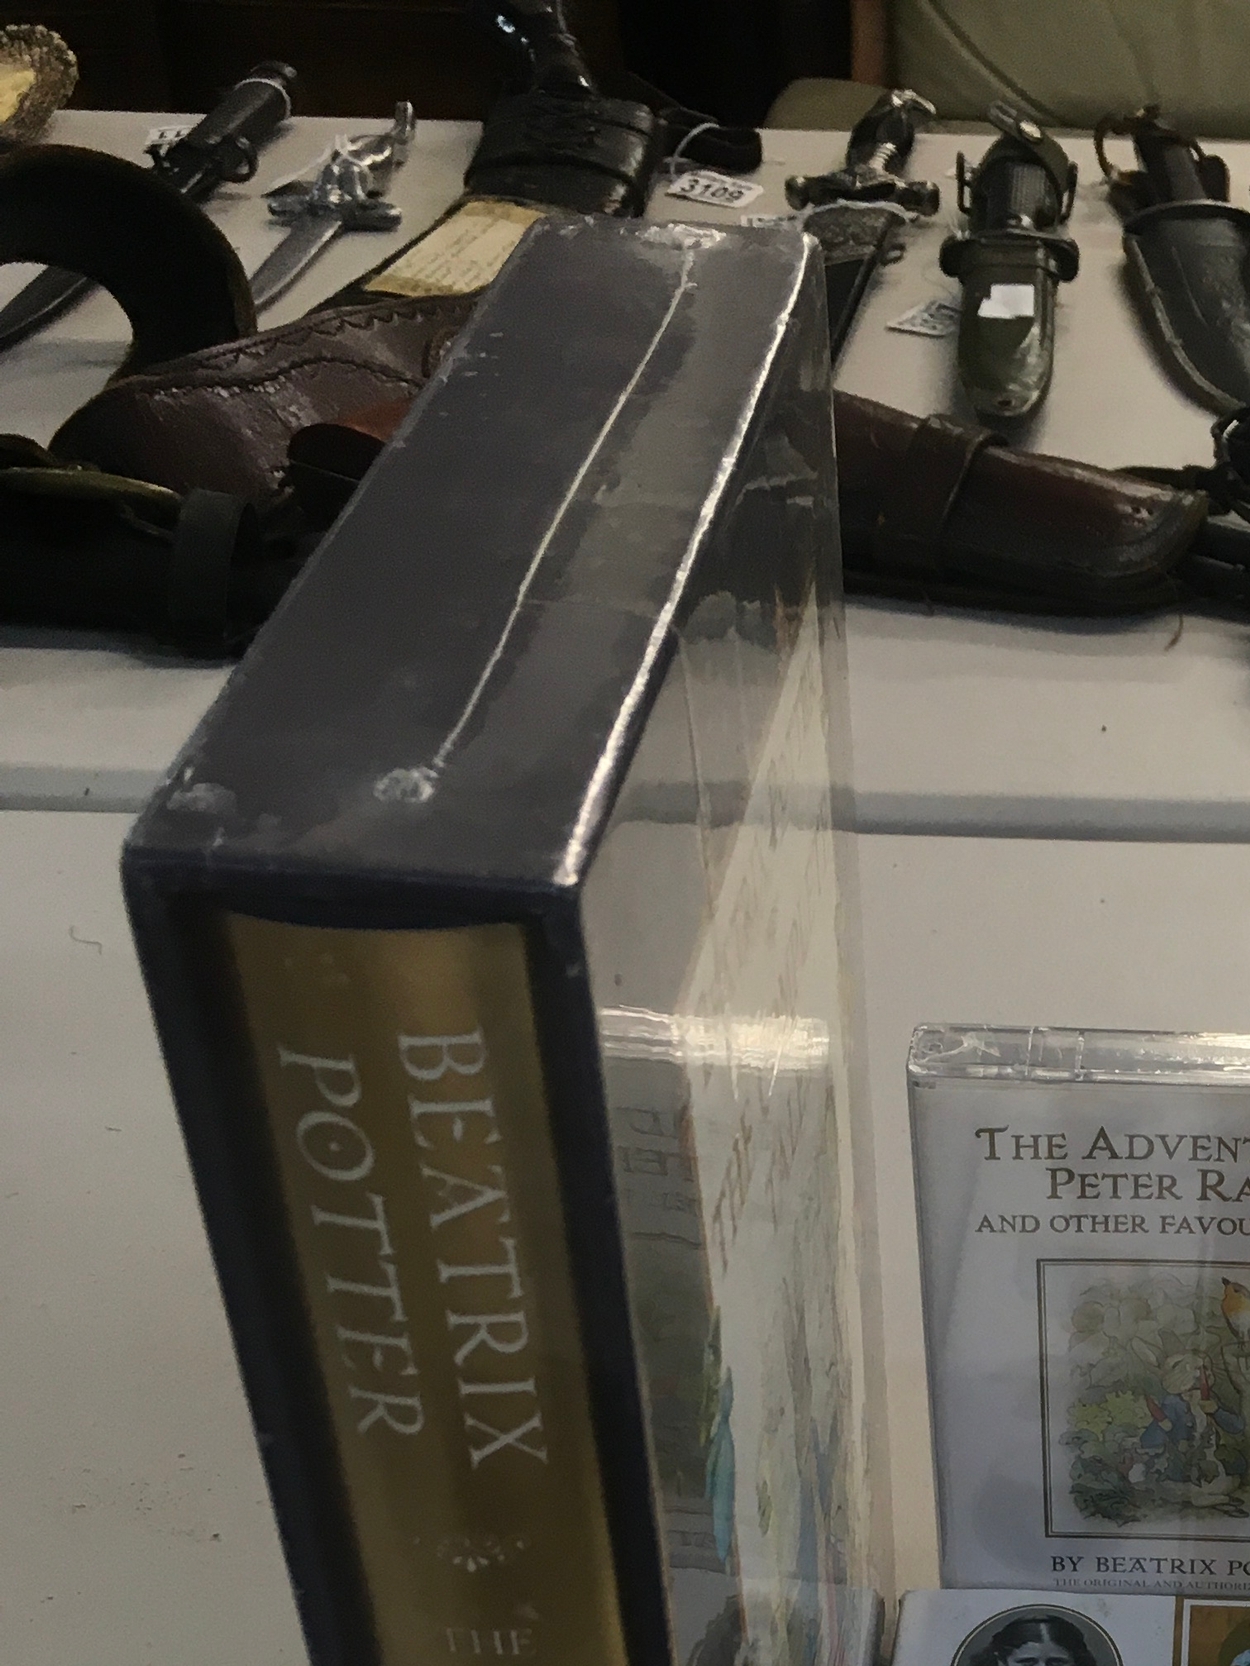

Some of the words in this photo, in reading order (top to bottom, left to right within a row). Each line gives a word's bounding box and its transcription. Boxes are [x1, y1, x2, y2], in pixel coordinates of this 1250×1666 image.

[974, 1124, 1068, 1161] THE
[1045, 1166, 1183, 1201] PETER
[277, 1044, 425, 1436] POTTER
[974, 1214, 1040, 1235] AND
[1049, 1214, 1150, 1235] OTHER
[398, 1026, 549, 1468] BEATRIX
[1050, 1555, 1085, 1573] BY
[1096, 1556, 1218, 1576] BEATRIX
[1053, 1578, 1081, 1587] THE
[1084, 1578, 1150, 1588] ORIGINAL
[1154, 1580, 1184, 1589] AND
